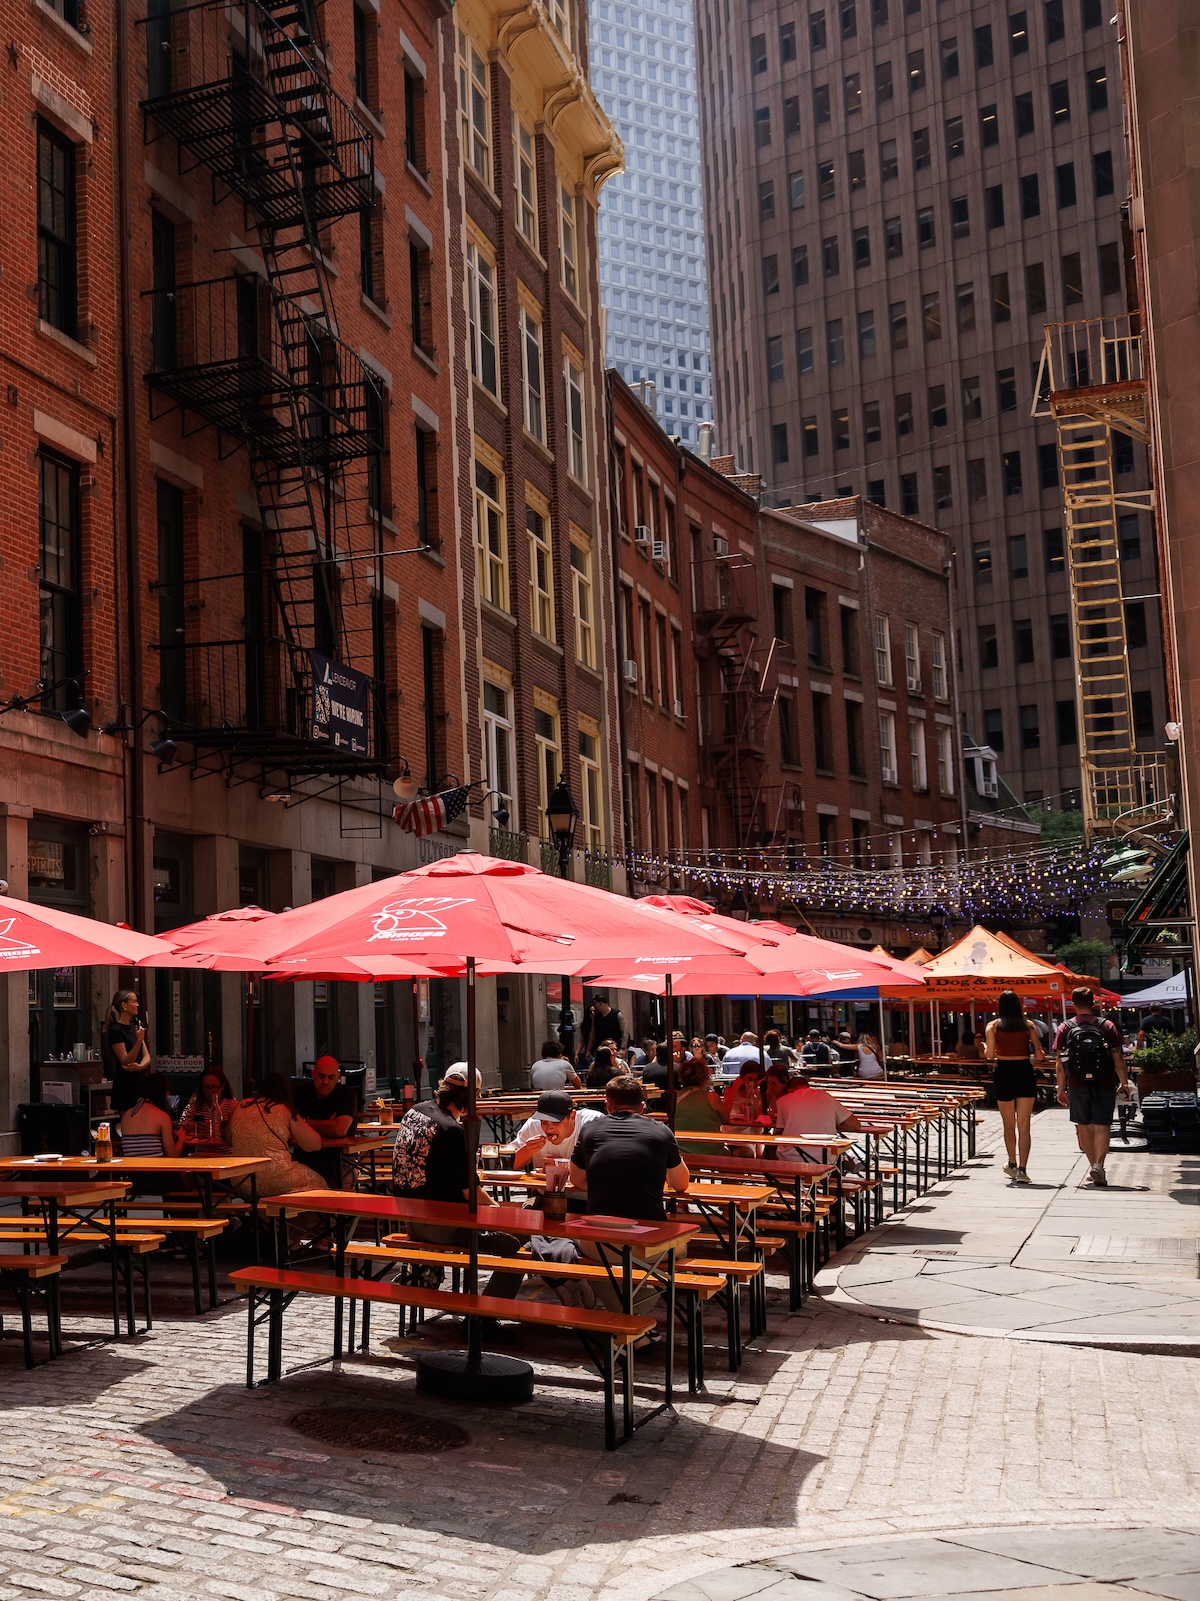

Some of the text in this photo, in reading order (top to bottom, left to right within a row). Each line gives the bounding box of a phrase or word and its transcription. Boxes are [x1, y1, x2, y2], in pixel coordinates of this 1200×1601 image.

[331, 699, 364, 728] WE'RE HIRING
[27, 856, 63, 876] SPIRITS
[936, 978, 971, 988] Dog
[973, 977, 989, 986] &
[992, 977, 1050, 985] Beans
